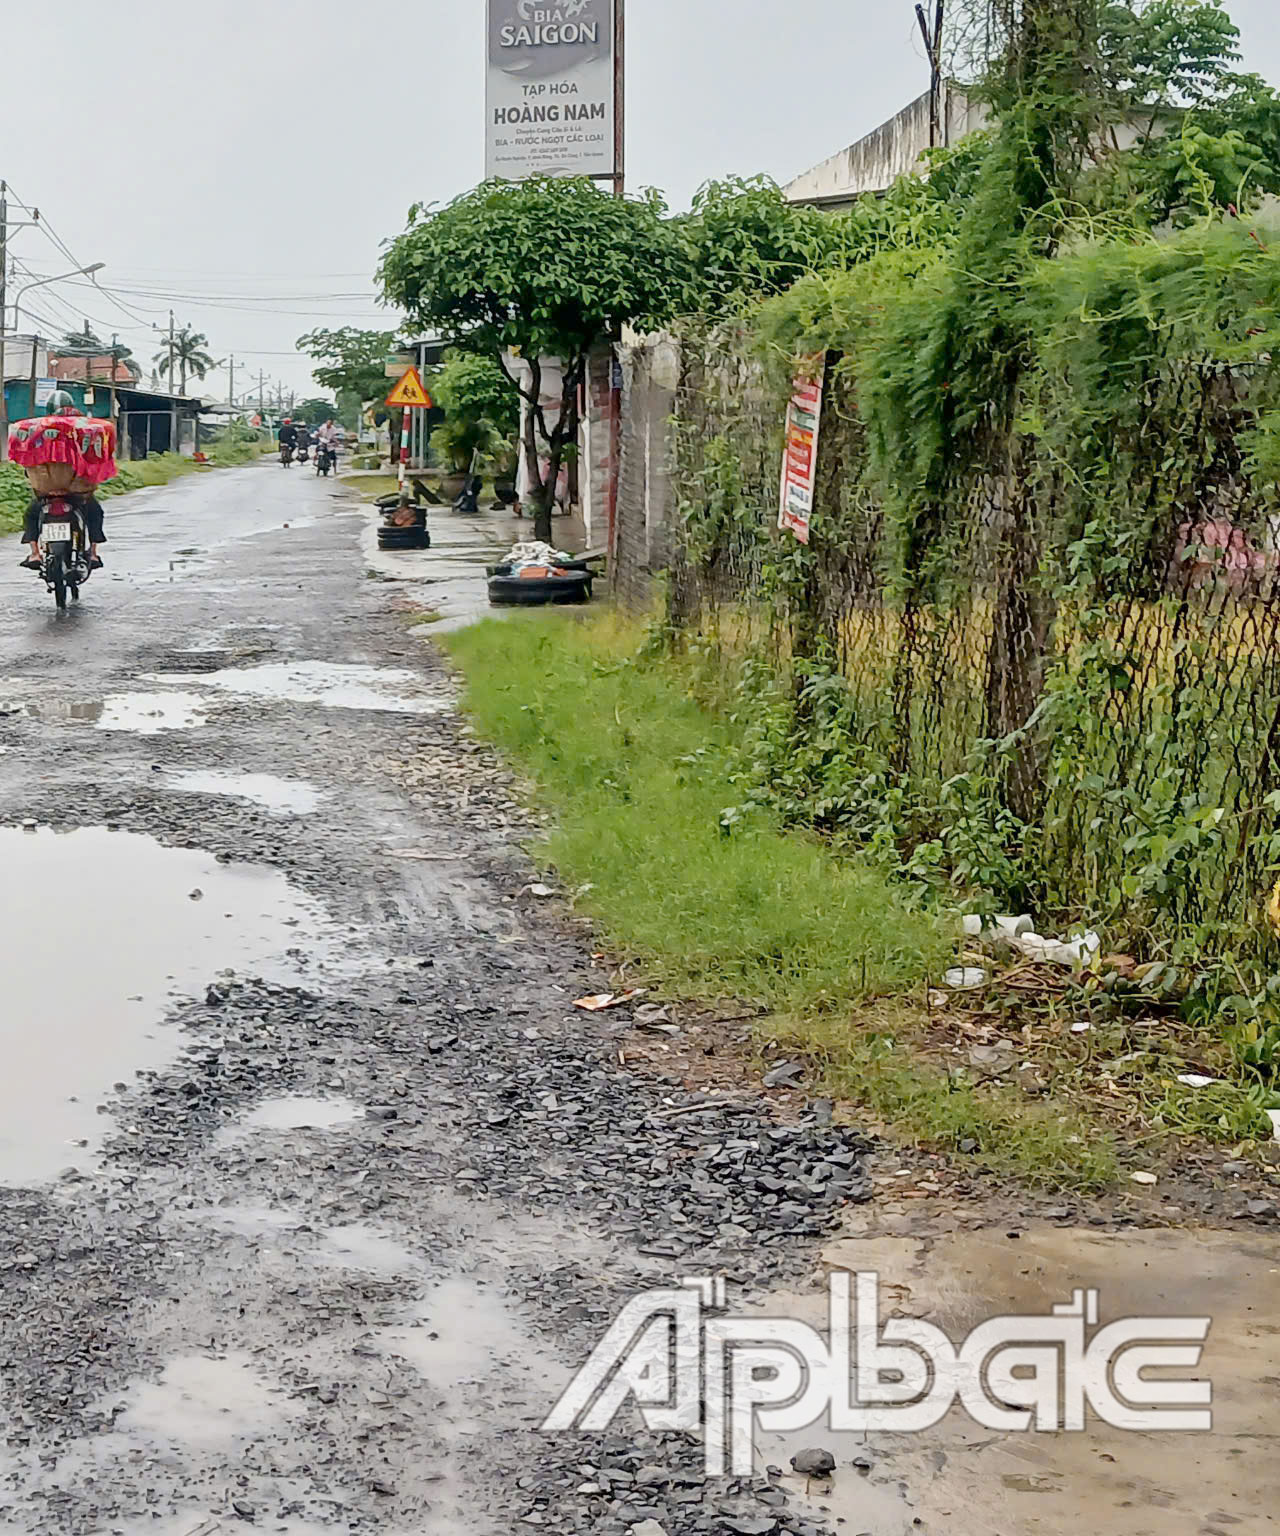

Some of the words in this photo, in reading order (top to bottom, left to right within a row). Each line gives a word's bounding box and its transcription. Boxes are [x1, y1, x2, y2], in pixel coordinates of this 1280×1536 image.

[534, 9, 563, 23] BIA
[500, 22, 598, 47] SAIGON
[522, 84, 546, 100] TẠP
[549, 80, 578, 95] HÓA
[494, 101, 560, 125] HOÀNG
[564, 102, 605, 121] NAM
